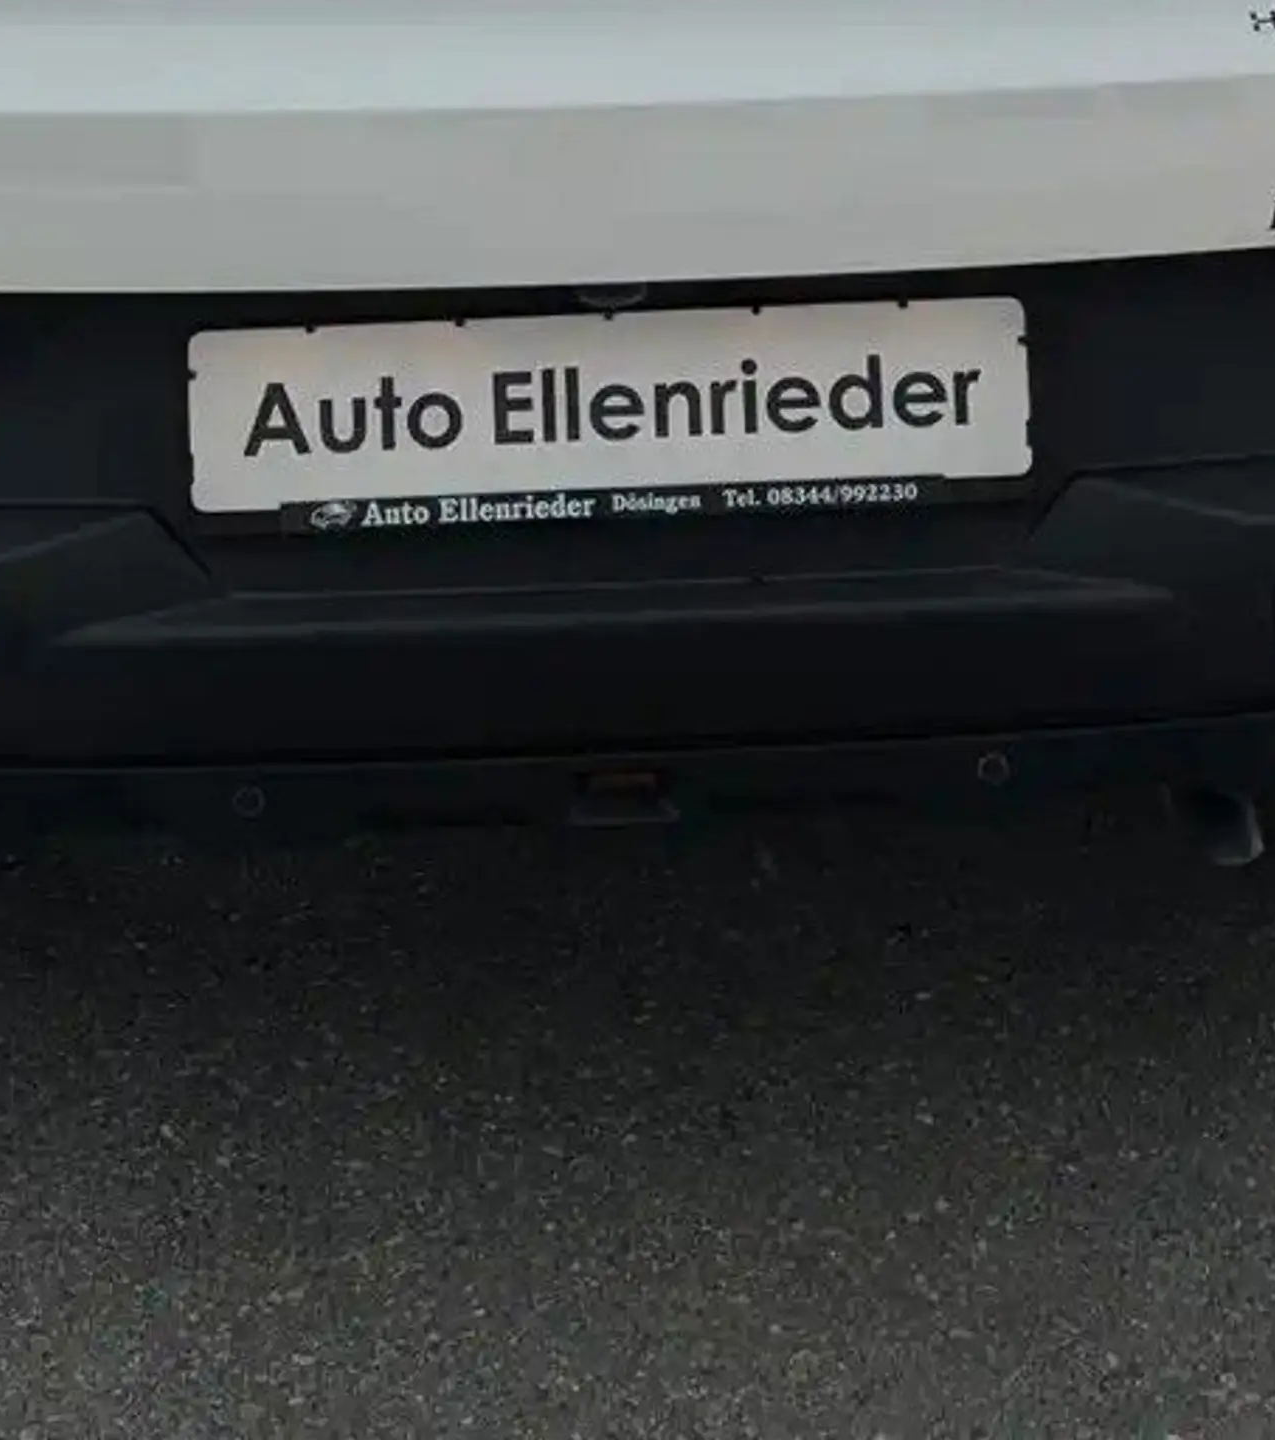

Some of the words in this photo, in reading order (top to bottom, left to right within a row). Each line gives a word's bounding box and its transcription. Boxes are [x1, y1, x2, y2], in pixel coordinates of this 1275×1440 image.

[243, 376, 463, 457] Auto
[492, 355, 982, 445] Ellenrieder
[360, 500, 431, 527] Auto
[437, 492, 597, 523] Ellenrieder
[611, 493, 701, 515] Dösingen
[723, 488, 762, 509] Tel.
[766, 482, 918, 507] 08344/992230
